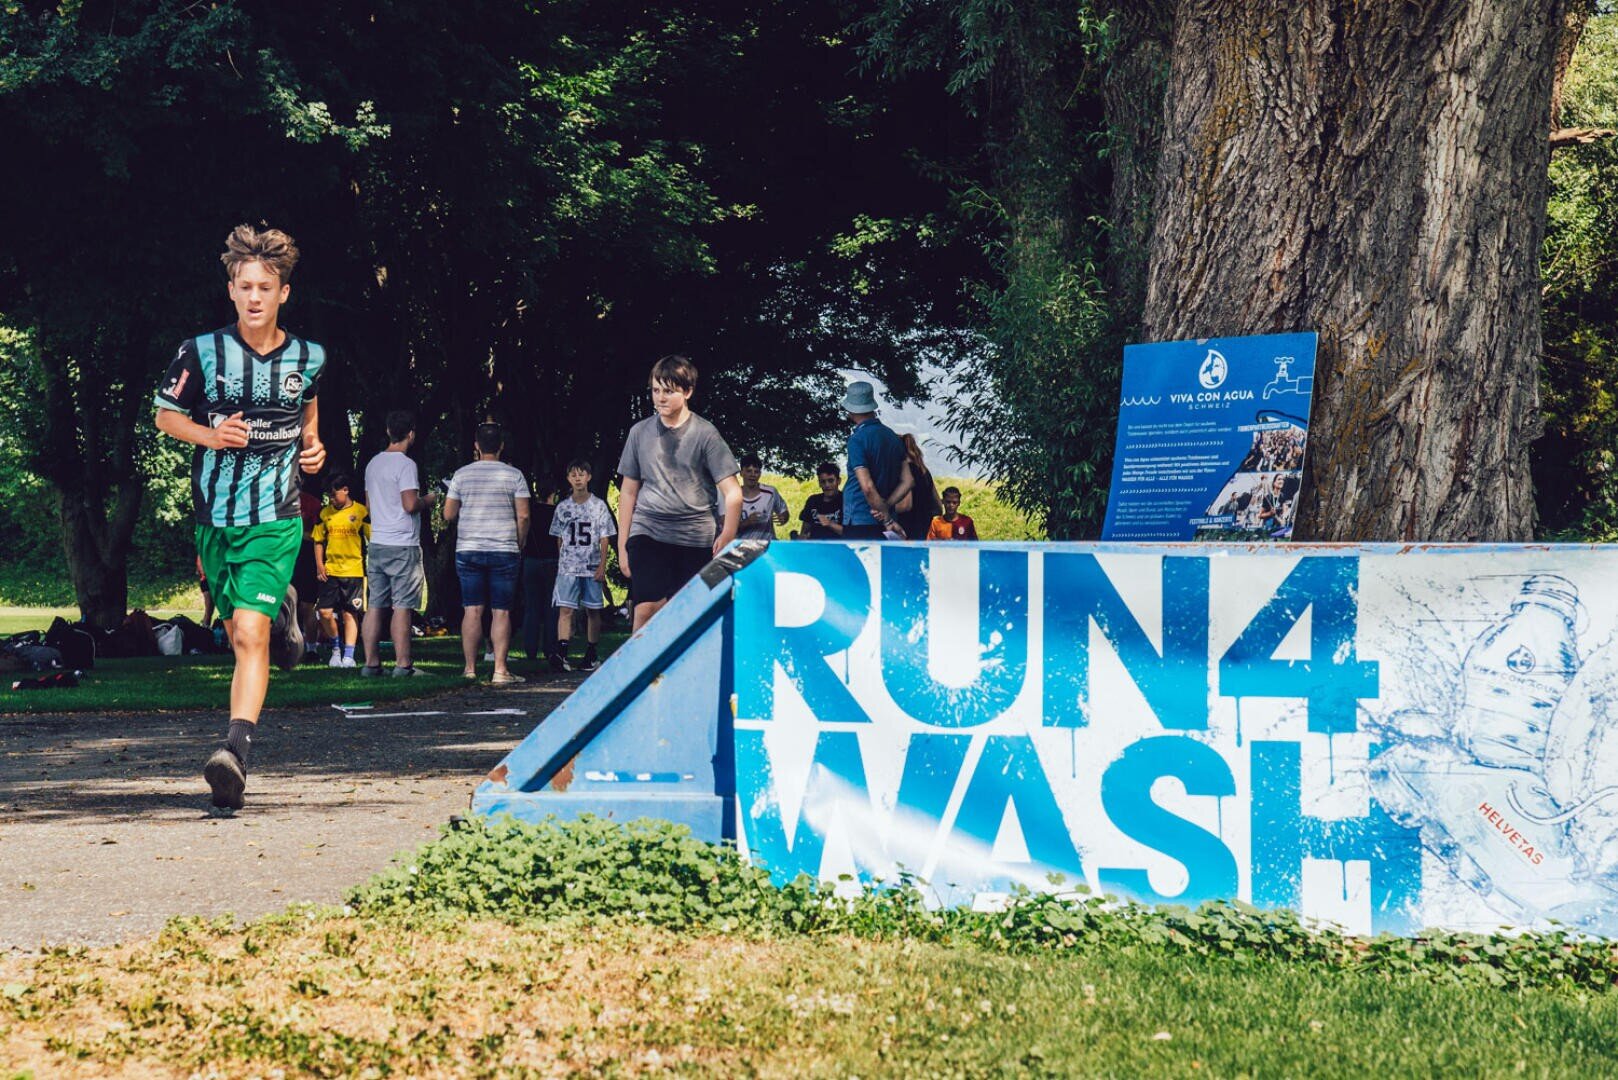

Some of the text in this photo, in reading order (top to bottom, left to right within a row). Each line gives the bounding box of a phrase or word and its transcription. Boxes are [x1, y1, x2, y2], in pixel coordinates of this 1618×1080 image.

[1170, 389, 1254, 404] VIVA CON AGUA
[1187, 402, 1231, 410] SCHWEIZ
[247, 425, 301, 440] ntonalbank
[569, 521, 592, 547] 15
[256, 592, 277, 605] JAKO
[734, 543, 1380, 734] RUN4
[734, 729, 1424, 938] WASH
[1478, 802, 1544, 865] HELVETAS
